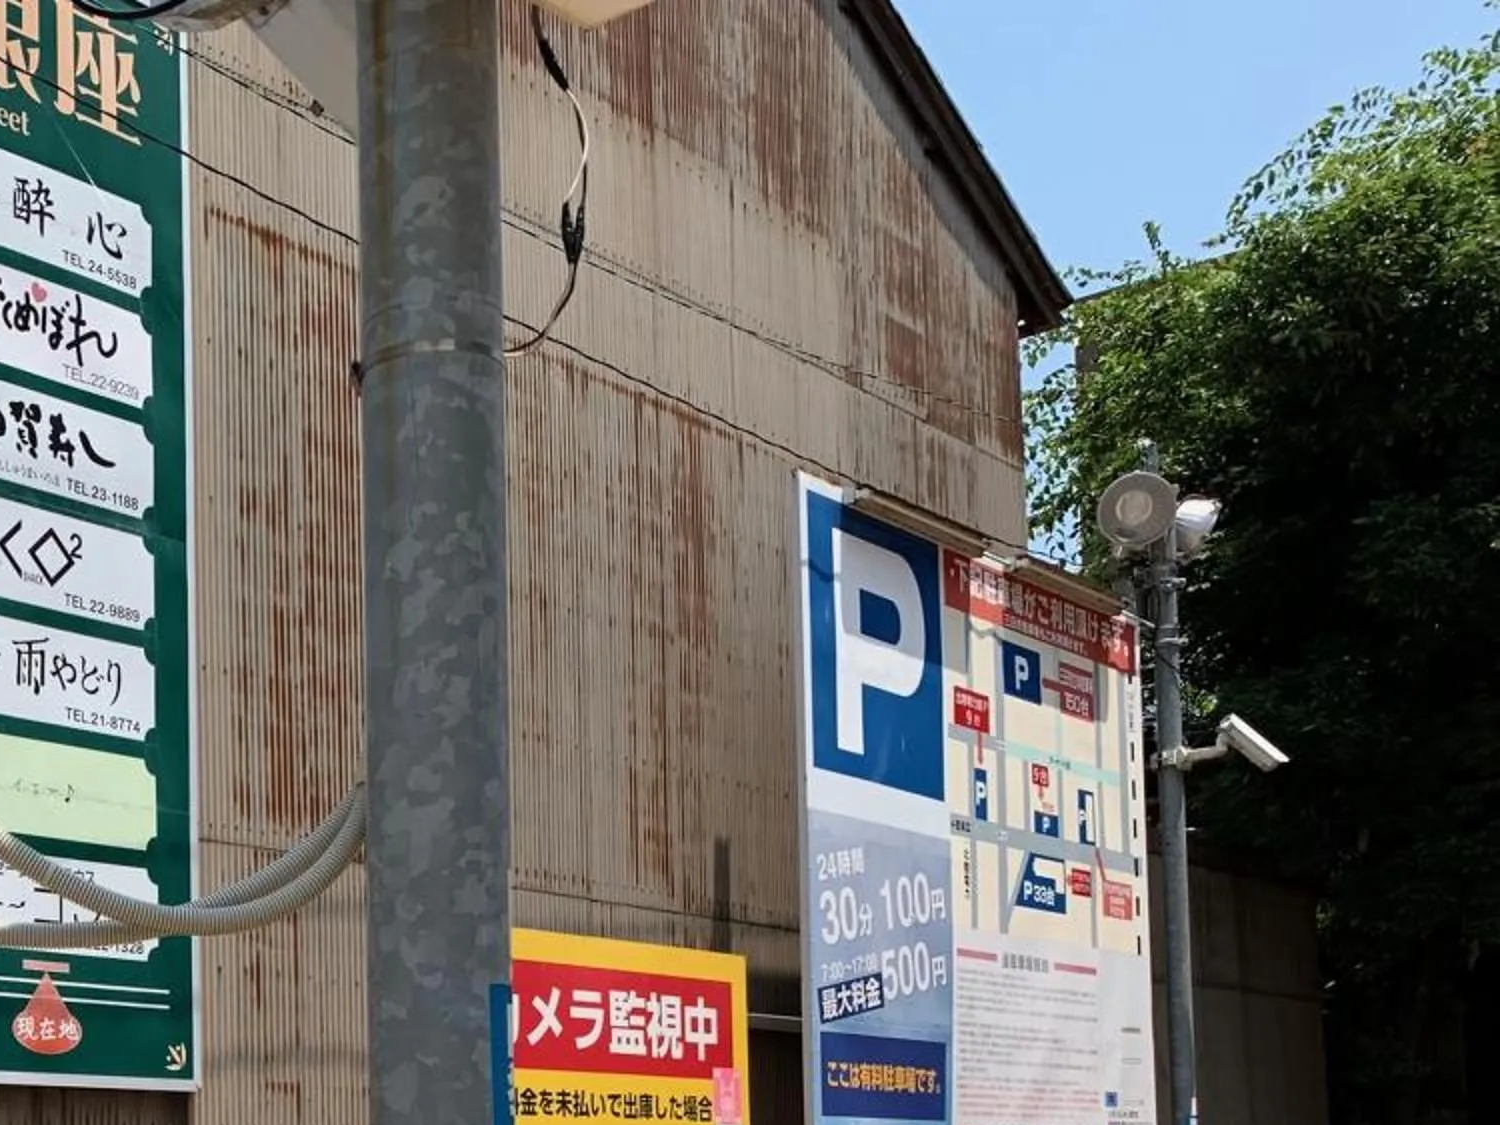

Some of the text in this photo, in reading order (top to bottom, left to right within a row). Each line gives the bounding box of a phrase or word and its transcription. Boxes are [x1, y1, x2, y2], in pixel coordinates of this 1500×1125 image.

[832, 527, 926, 757] P
[12, 638, 122, 706] 雨やどり
[1015, 655, 1029, 690] P
[975, 780, 987, 806] P
[816, 846, 865, 881] 24時間
[820, 886, 873, 945] 30分
[880, 872, 946, 930] 100円
[882, 941, 947, 1000] 500円
[822, 977, 881, 1020] 最大料金
[16, 1016, 80, 1041] 現在地
